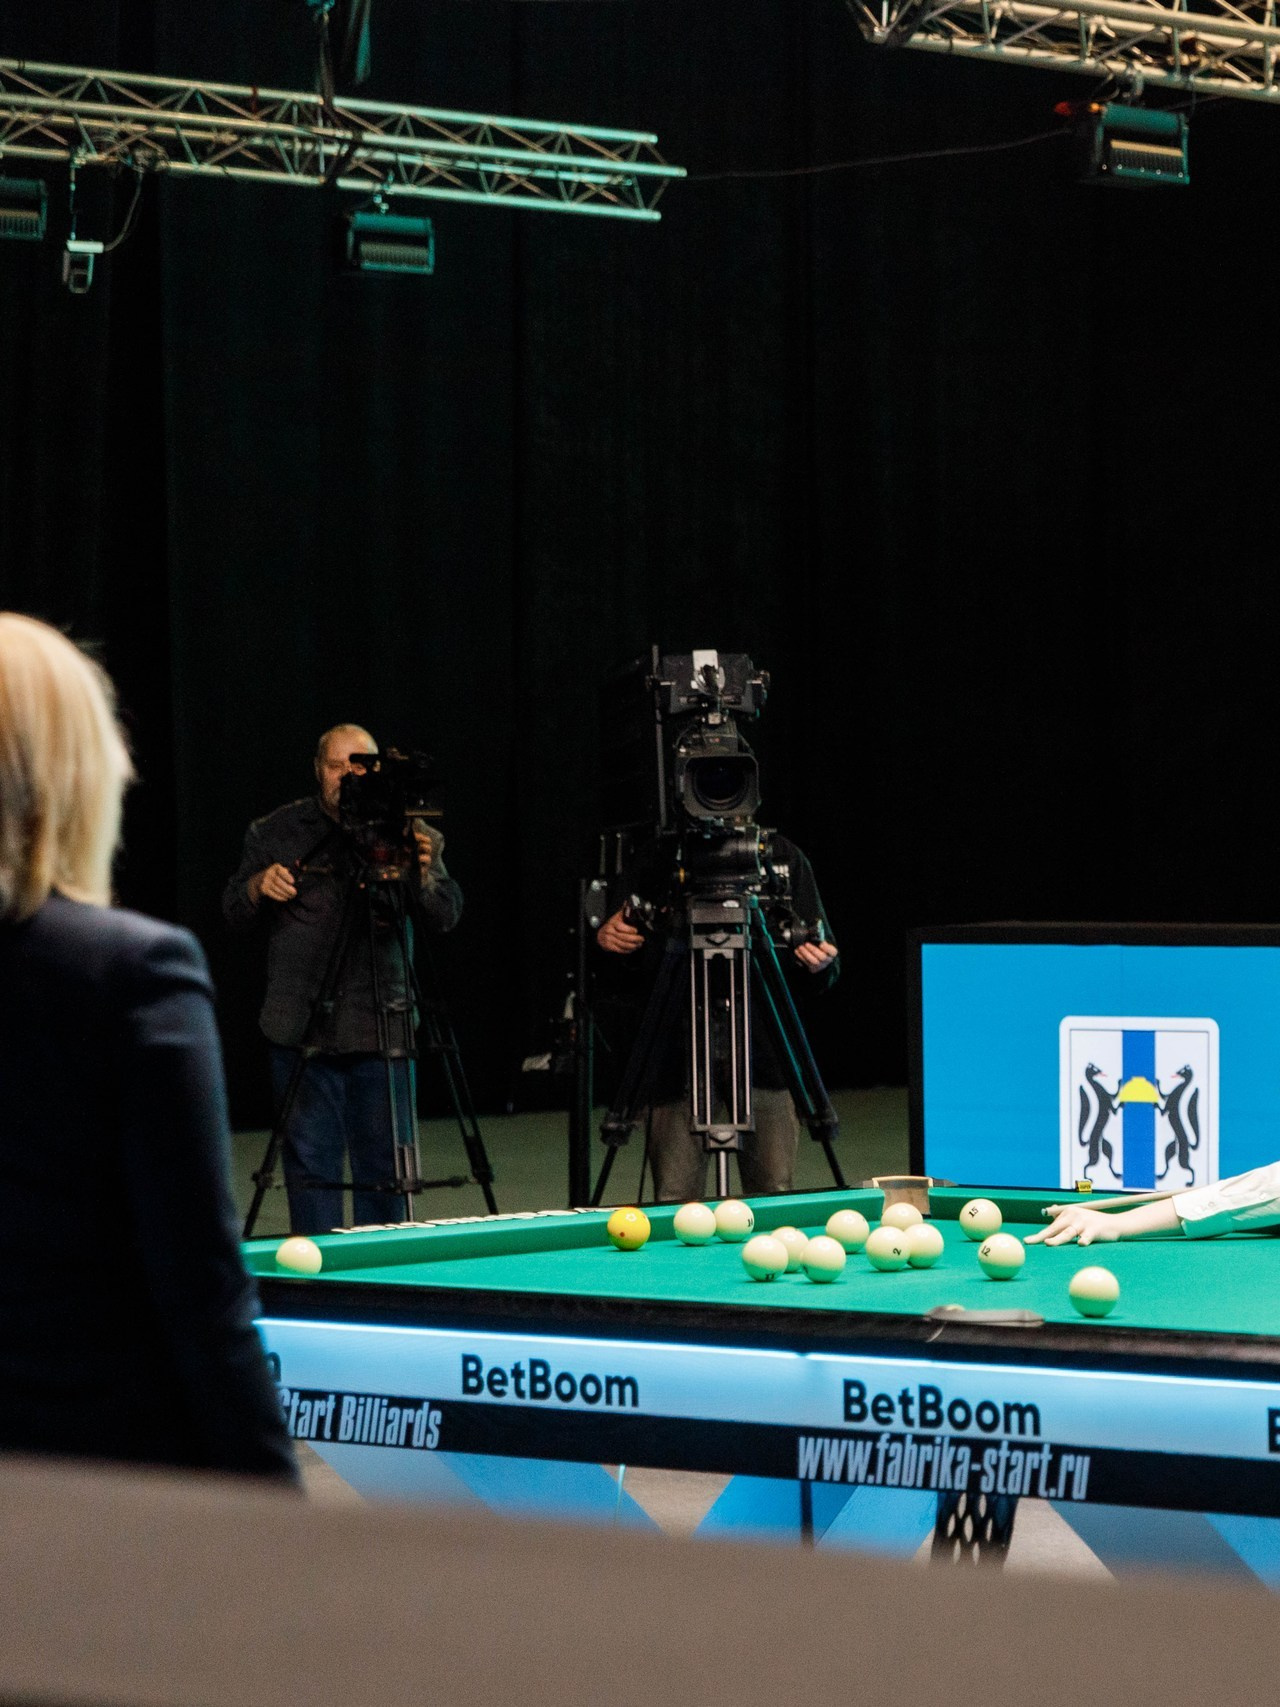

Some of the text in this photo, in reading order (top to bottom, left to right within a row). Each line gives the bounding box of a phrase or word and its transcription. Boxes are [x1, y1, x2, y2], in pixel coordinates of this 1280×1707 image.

[968, 1206, 979, 1218] 15
[892, 1247, 902, 1256] 2
[981, 1245, 991, 1257] 12
[462, 1353, 639, 1408] BetBoom
[843, 1378, 1041, 1436] BetBoom
[338, 1395, 443, 1449] Billiards
[799, 1432, 1091, 1500] www.fabrika-start.ru
